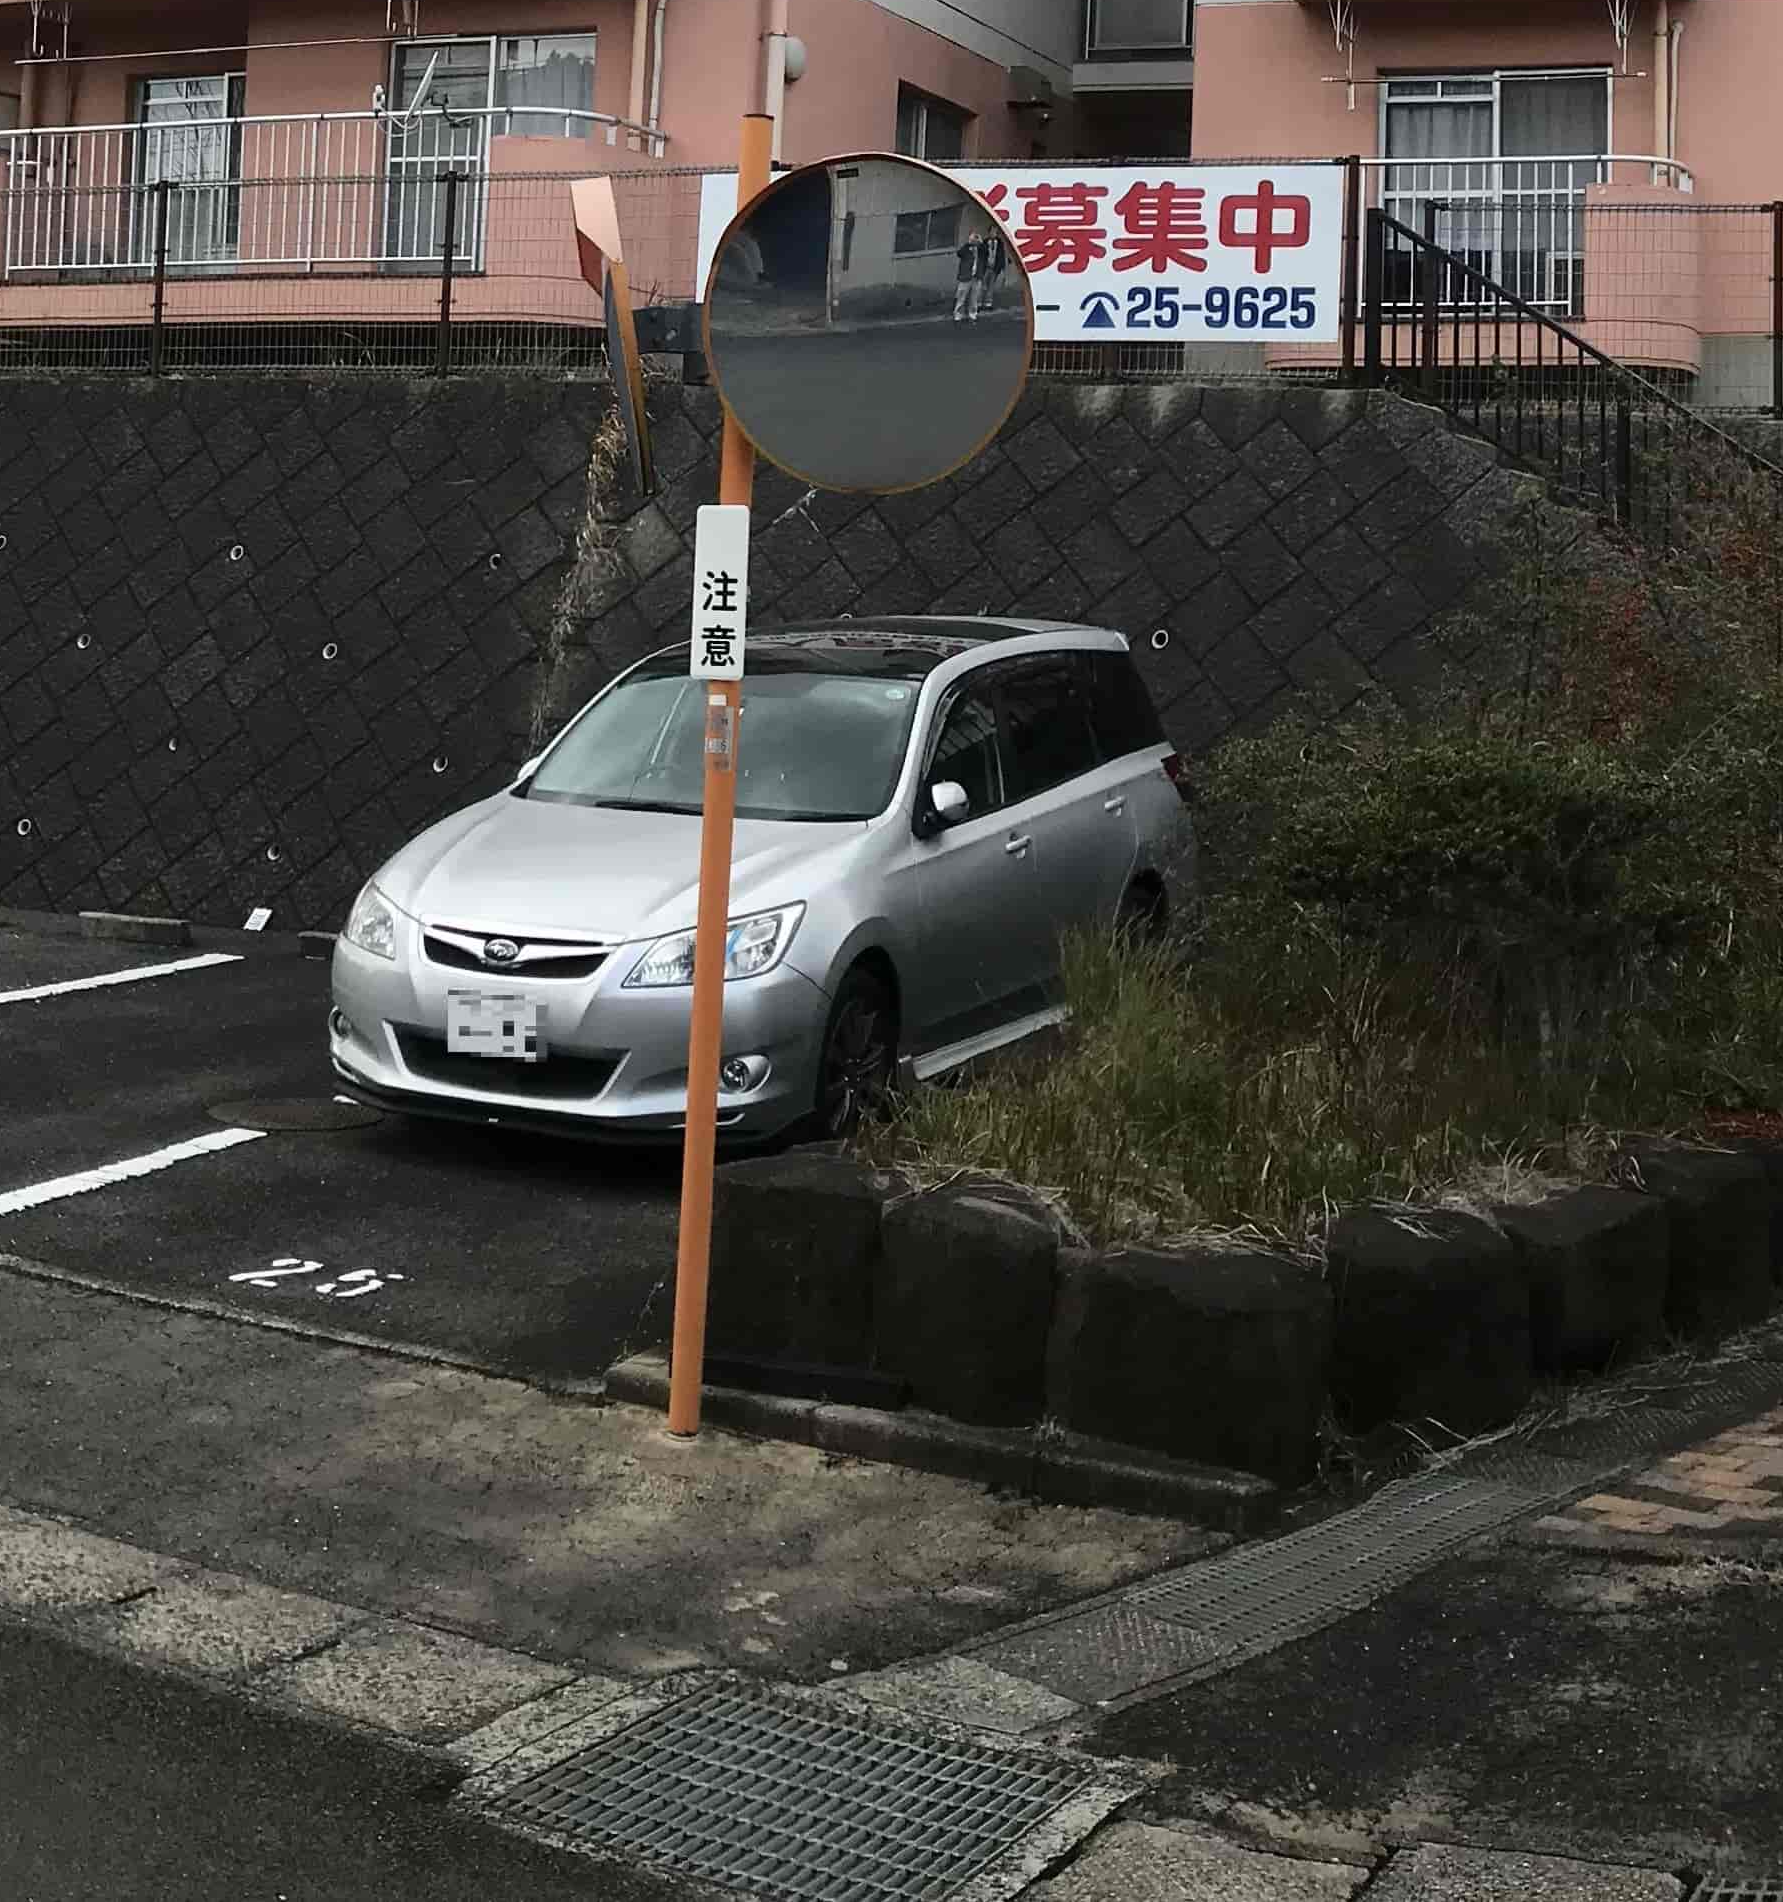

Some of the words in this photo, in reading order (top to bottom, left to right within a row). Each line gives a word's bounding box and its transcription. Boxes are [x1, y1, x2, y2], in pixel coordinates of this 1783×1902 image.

[1126, 286, 1316, 329] 25-9625
[701, 570, 738, 669] 注意
[227, 1256, 407, 1298] 25
